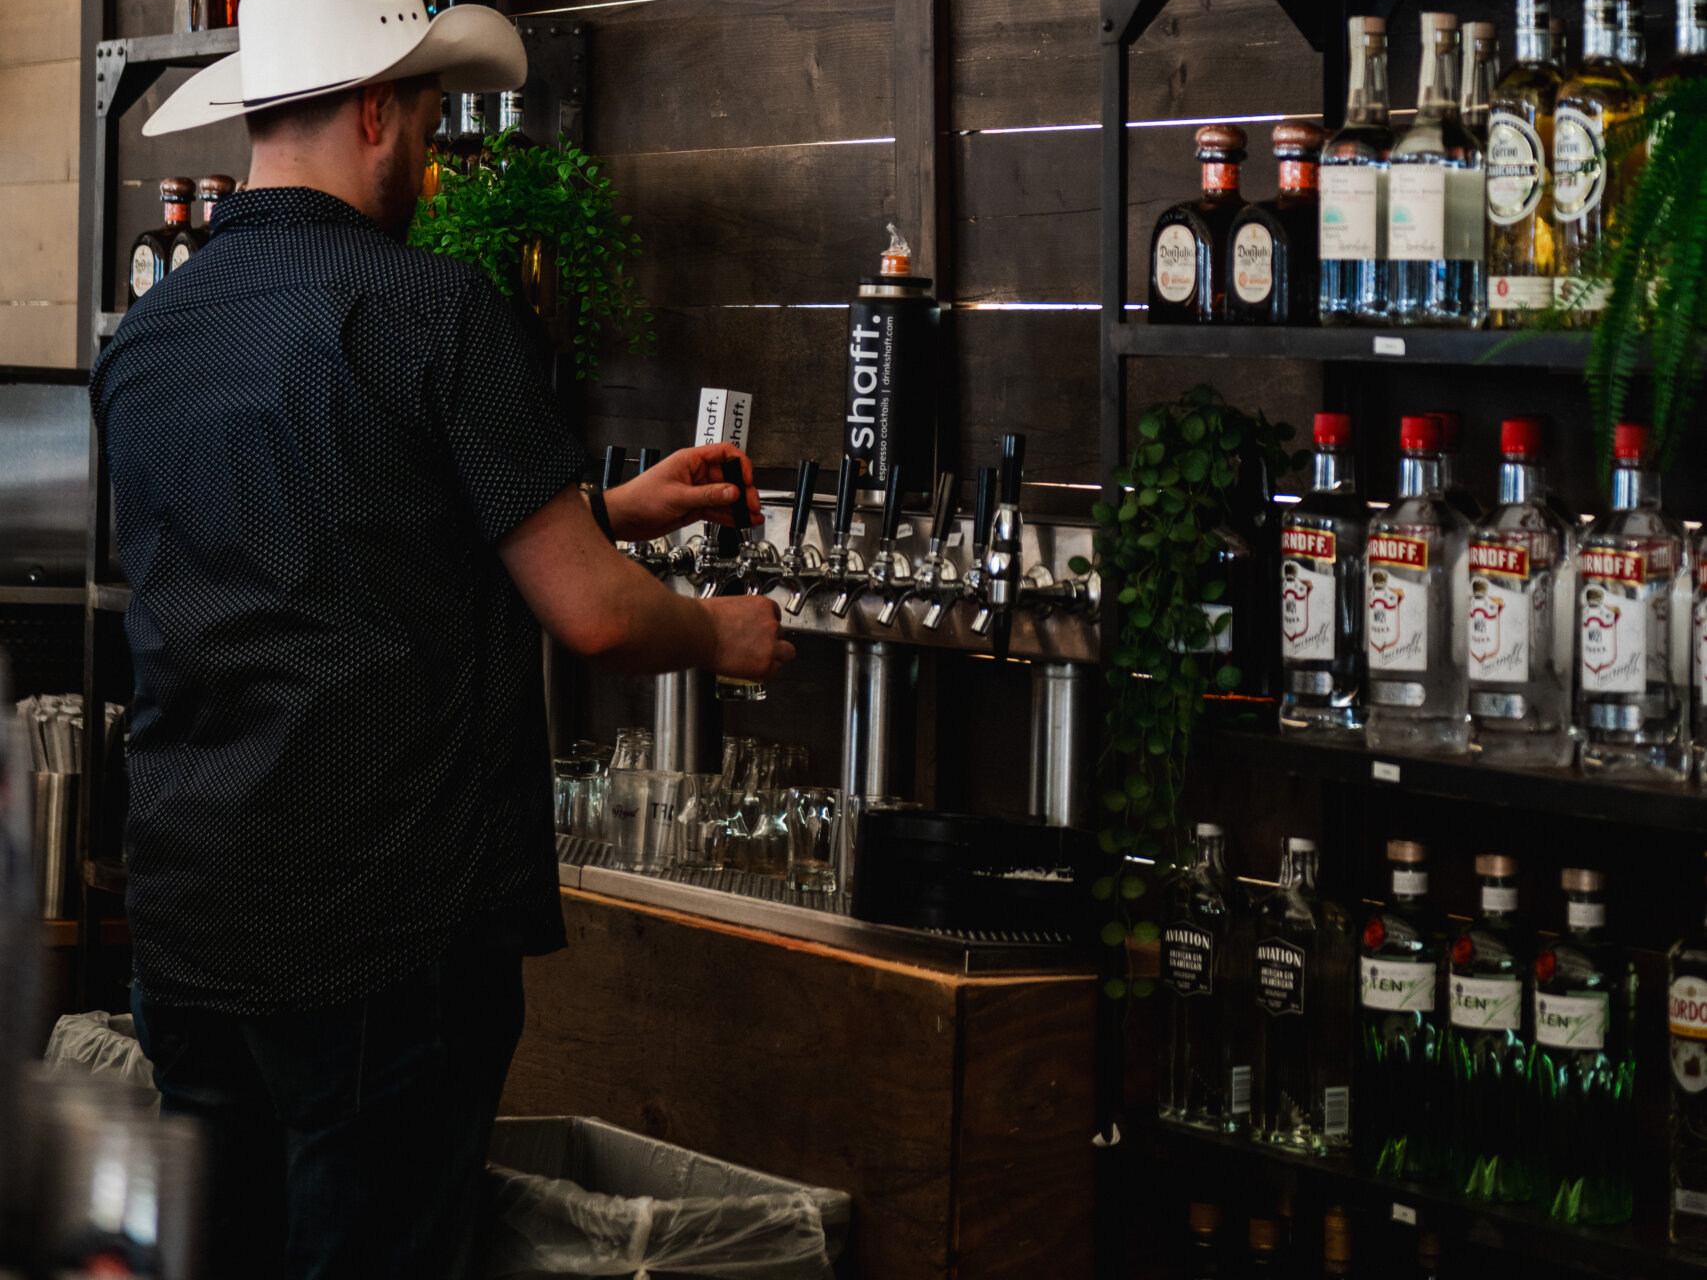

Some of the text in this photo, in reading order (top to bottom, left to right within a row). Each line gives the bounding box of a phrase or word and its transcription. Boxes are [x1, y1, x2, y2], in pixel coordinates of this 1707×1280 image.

[847, 315, 881, 449] shaft.
[879, 316, 894, 481] espresso cocktails drinkshaft.com
[704, 396, 719, 445] shaft.
[730, 399, 745, 448] shaft.
[1283, 531, 1326, 554] RNOFF
[1369, 538, 1417, 562] IRNOFF
[1470, 546, 1518, 570] IRNOFF
[1584, 553, 1635, 577] IRNOFF
[1165, 929, 1210, 950] AVIATION
[1257, 946, 1302, 968] AVIATION
